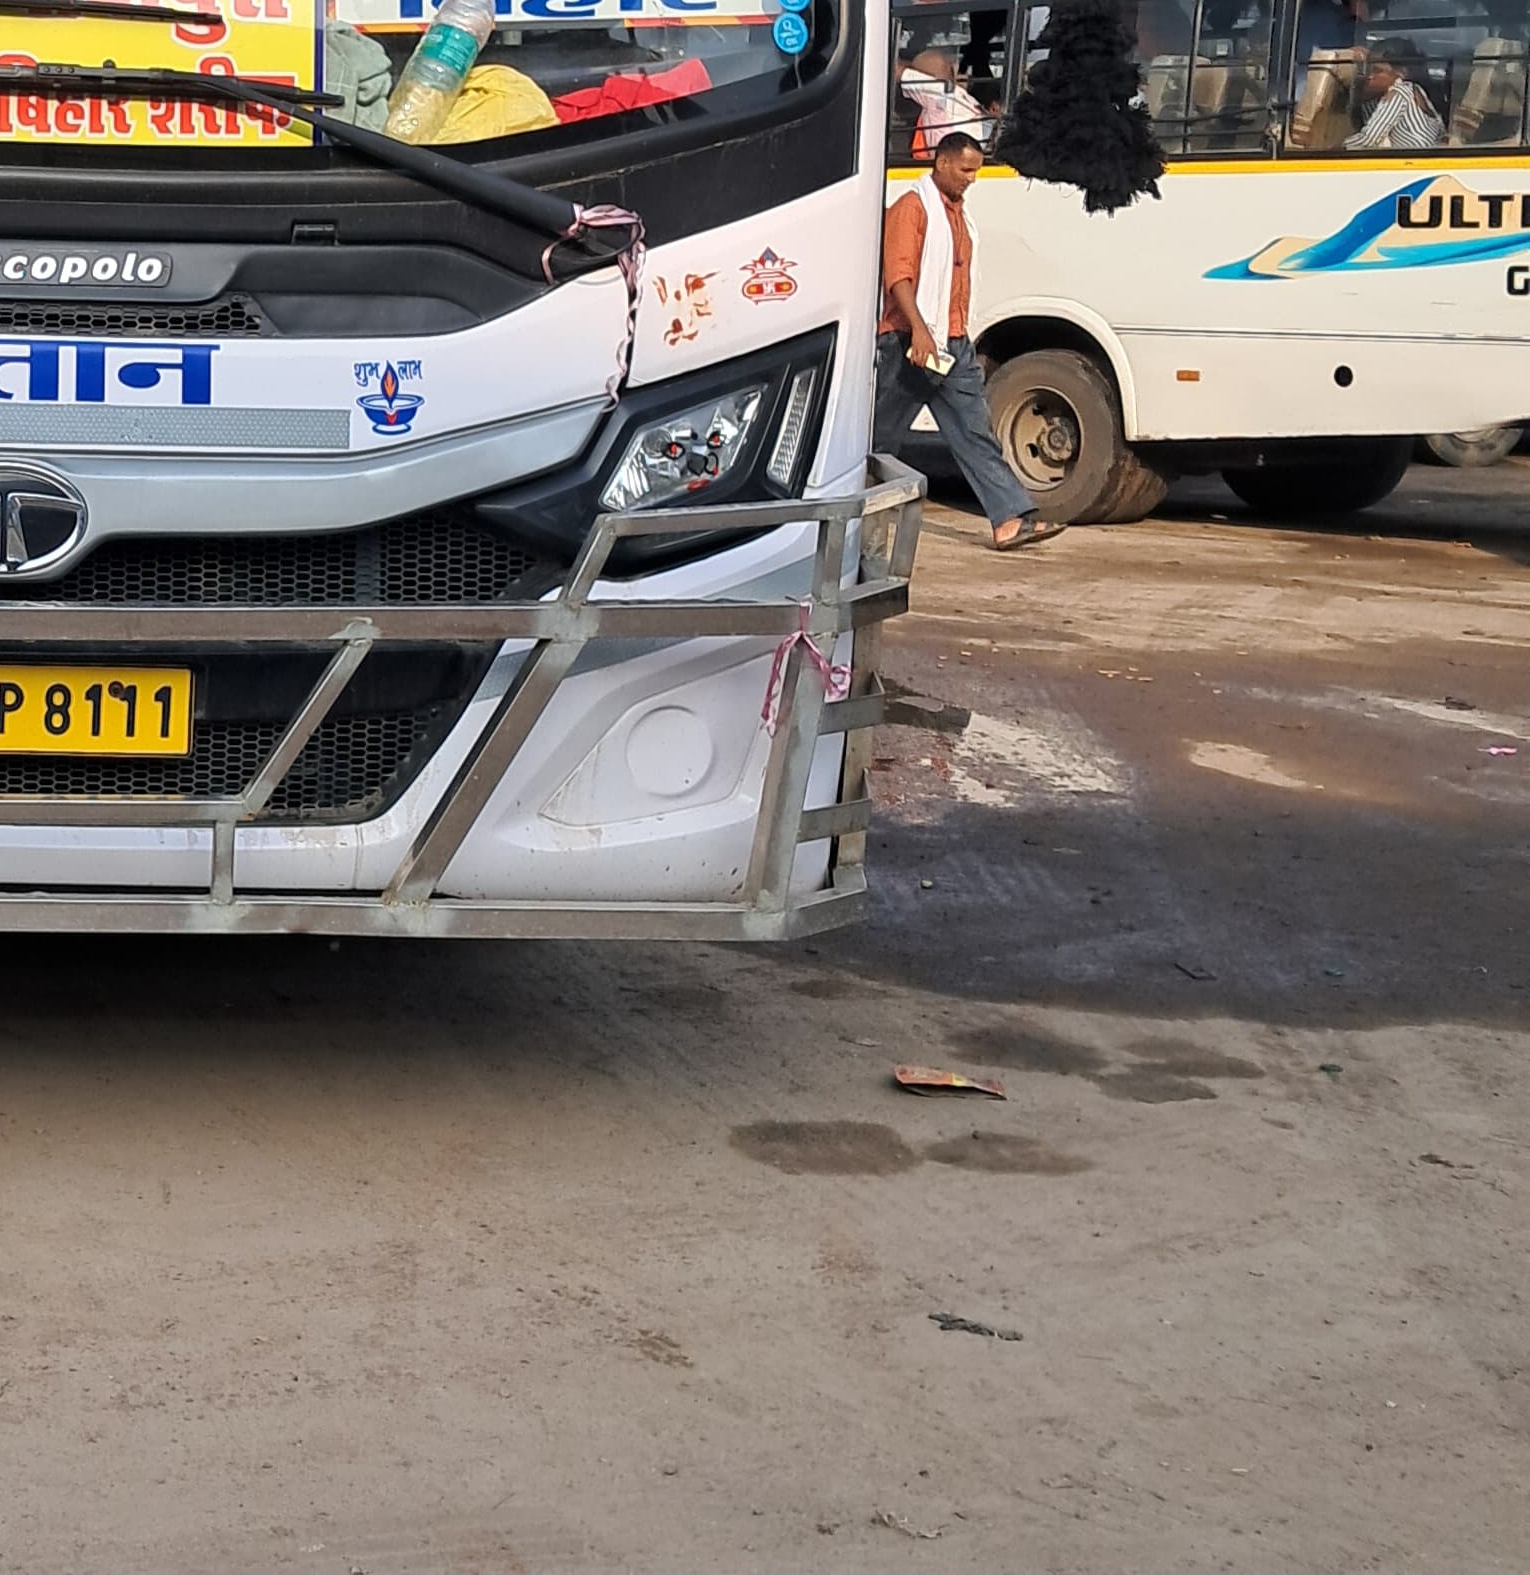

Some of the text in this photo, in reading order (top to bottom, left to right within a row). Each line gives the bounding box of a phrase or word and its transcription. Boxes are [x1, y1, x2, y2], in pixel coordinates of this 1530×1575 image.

[353, 360, 422, 387] शुभ लाभ
[44, 682, 173, 739] 8111
